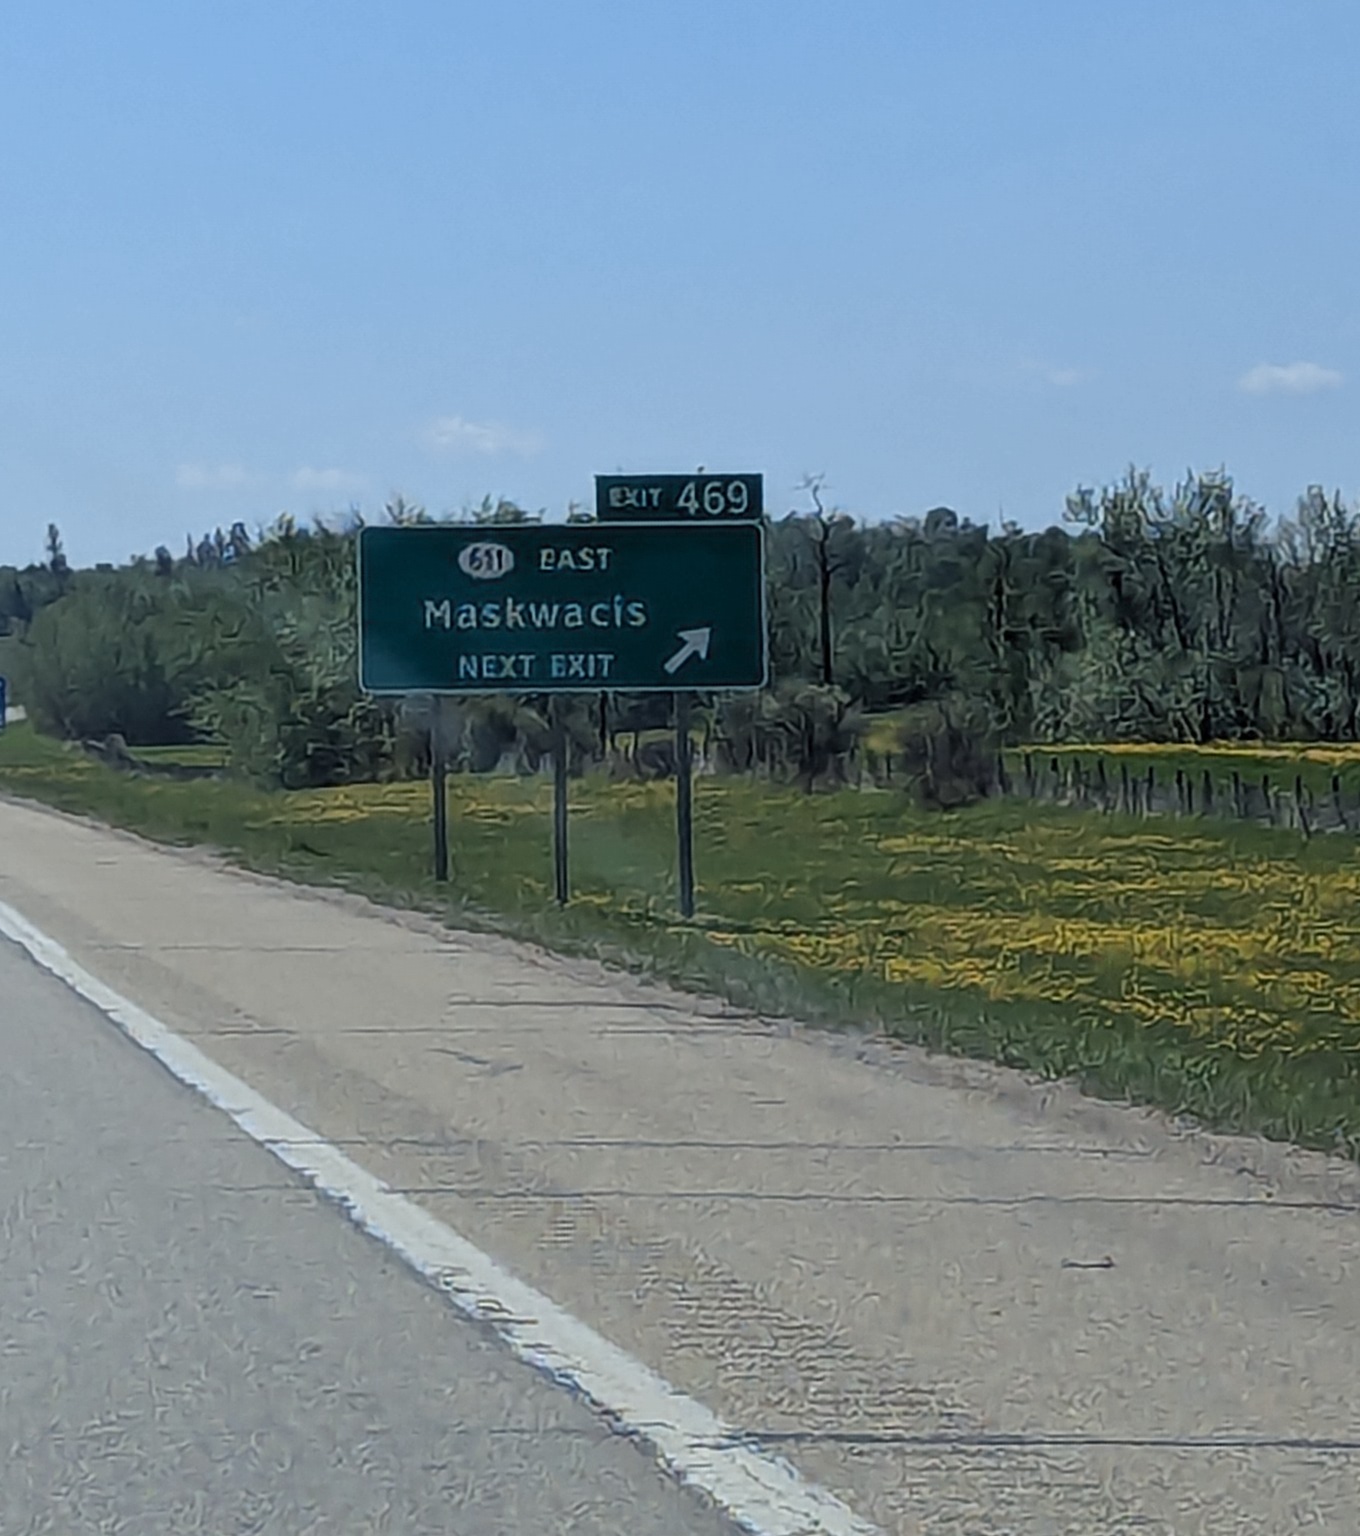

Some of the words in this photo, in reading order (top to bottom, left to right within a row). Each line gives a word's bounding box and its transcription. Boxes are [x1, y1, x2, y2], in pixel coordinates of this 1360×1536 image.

[609, 486, 662, 508] EXIT
[676, 480, 749, 515] 469
[539, 547, 613, 571] EAST
[424, 594, 647, 629] Maskwacis
[459, 654, 536, 679] NEXT
[551, 653, 615, 678] EXIT
